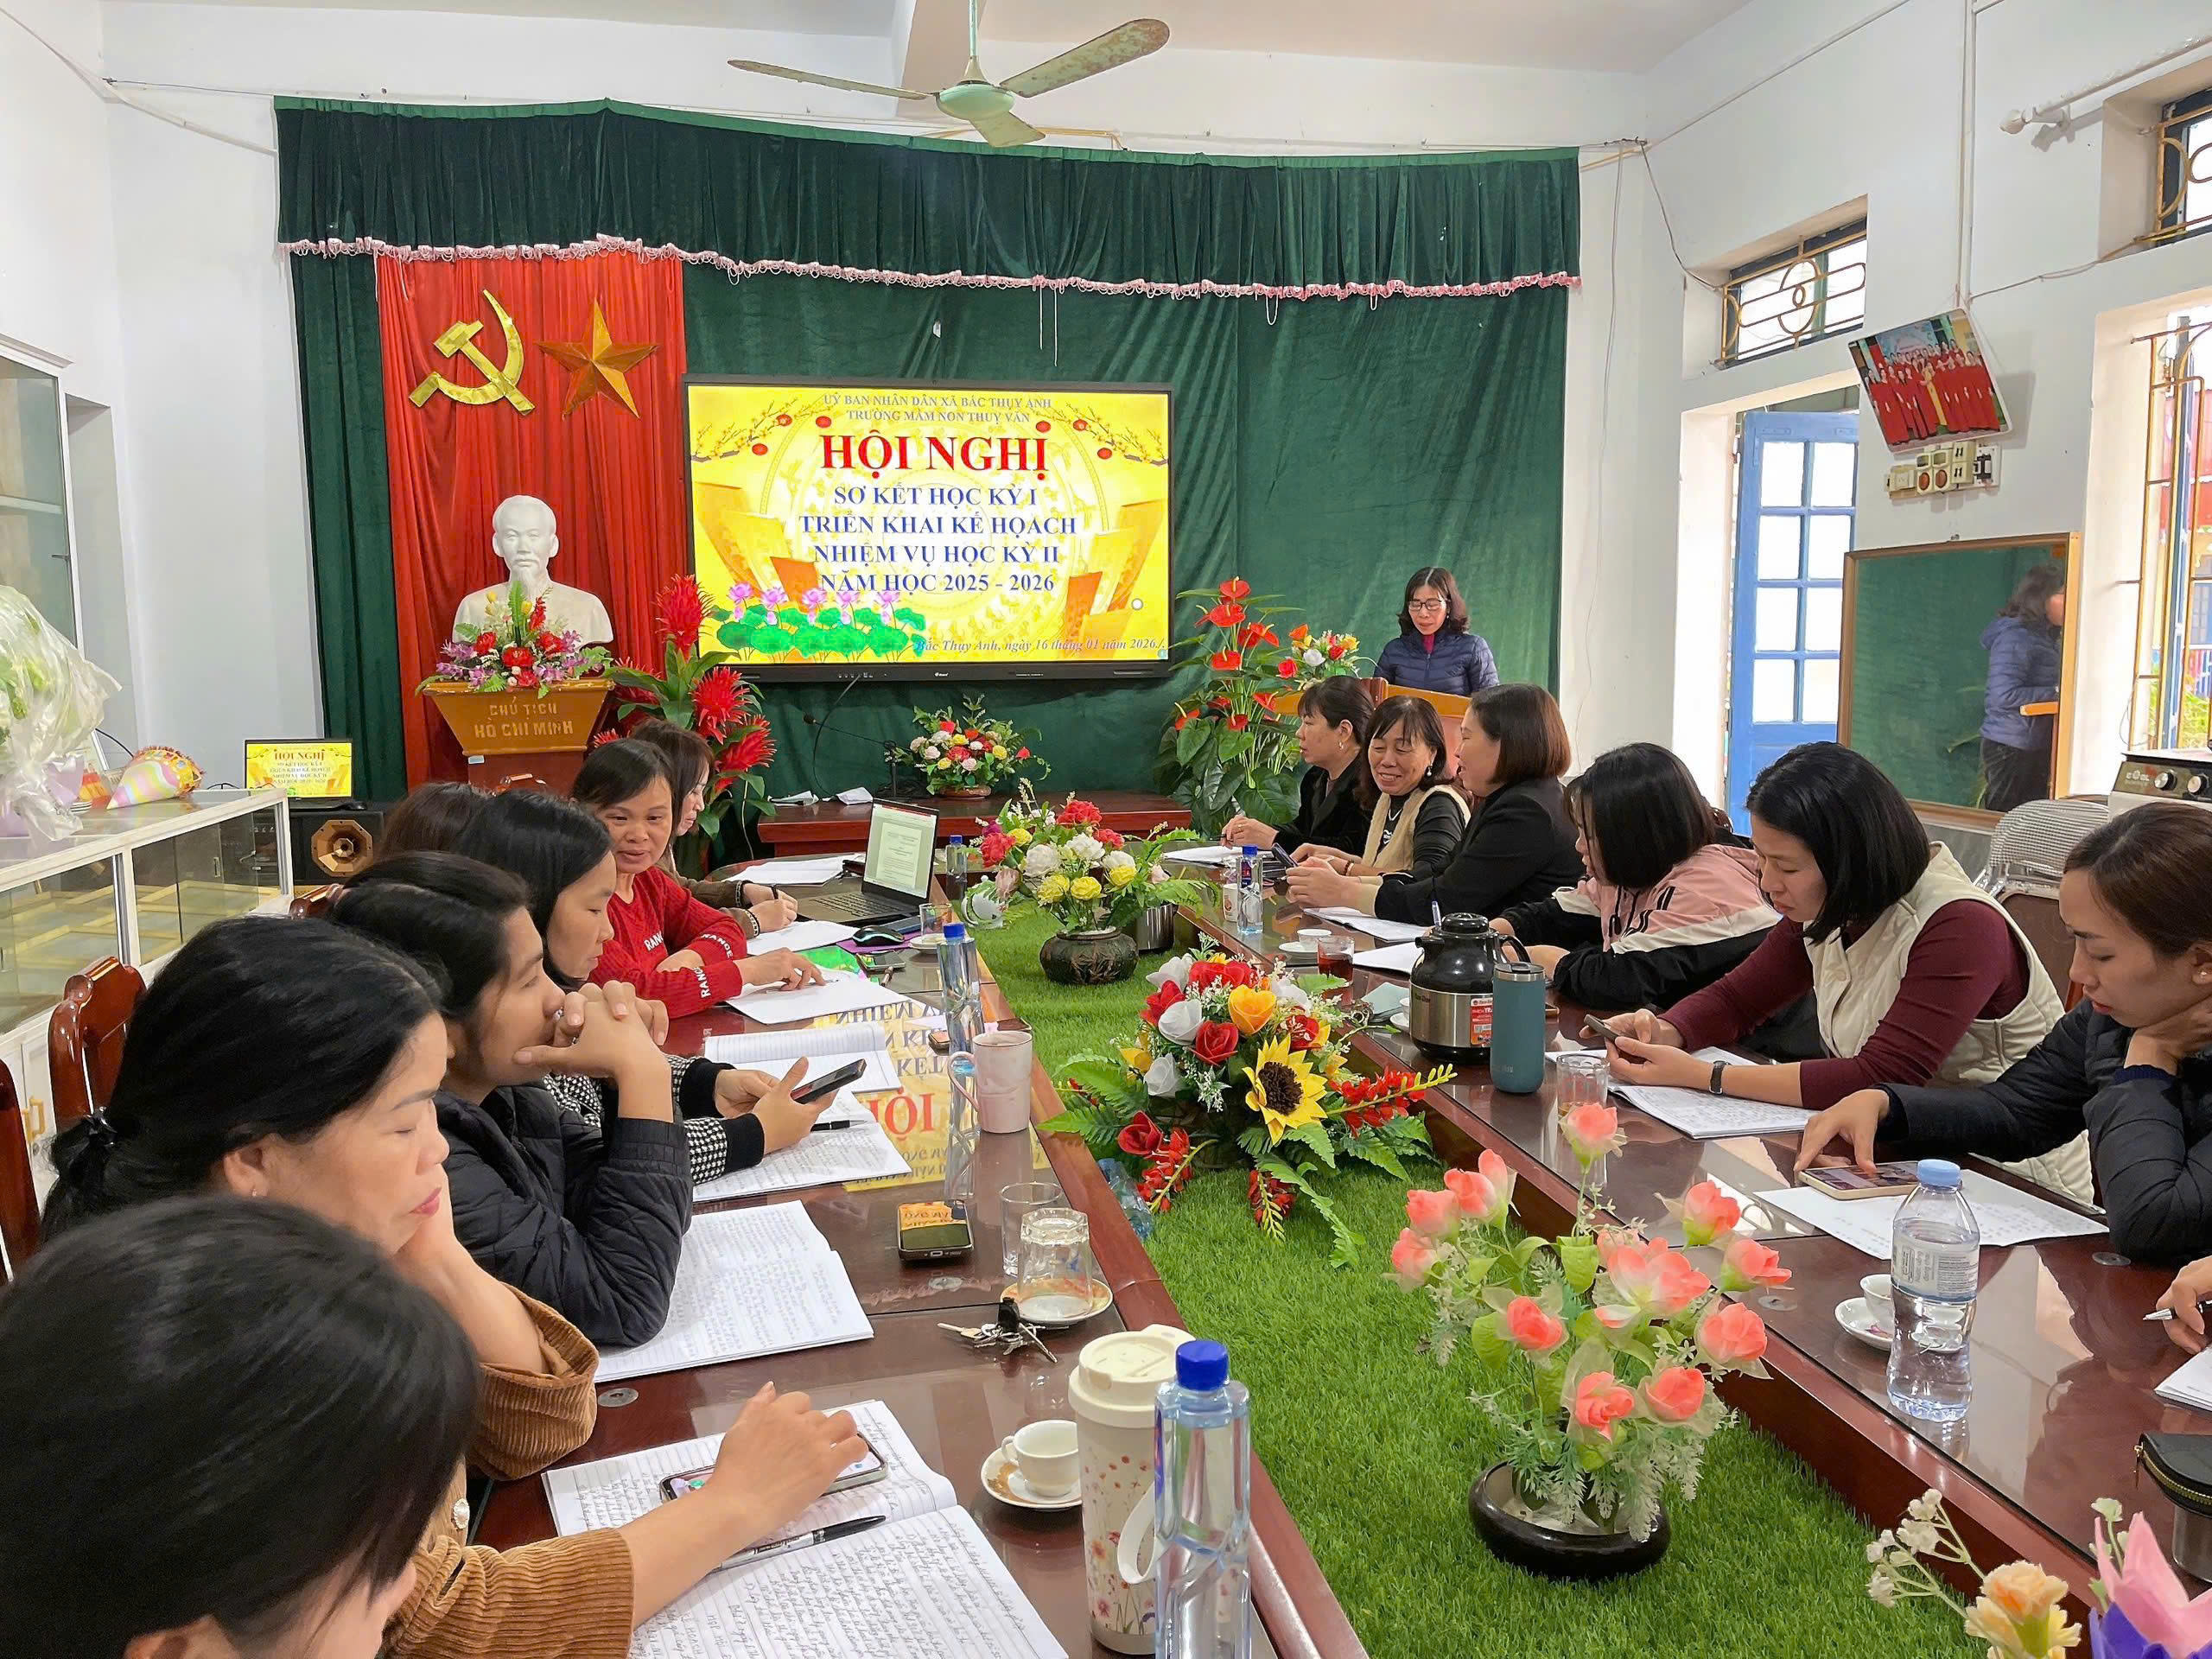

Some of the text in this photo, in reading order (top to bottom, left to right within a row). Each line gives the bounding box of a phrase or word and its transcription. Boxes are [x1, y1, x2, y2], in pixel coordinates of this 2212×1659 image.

[844, 395, 869, 405] BAN
[873, 393, 908, 406] NHÂN
[912, 394, 937, 406] DÂN
[941, 395, 957, 406] XÃ
[1026, 398, 1052, 409] ANH
[847, 408, 900, 421] TRƯỜNG
[904, 407, 934, 421] MẦM
[938, 411, 964, 422] NON
[819, 429, 1049, 481] HỘI NGHỊ
[834, 481, 1038, 510] SƠ KẾT HỌC KỲ I
[798, 511, 874, 534] TRIỂN
[882, 516, 944, 534] KHAI
[952, 510, 984, 534] KẾ
[814, 541, 1060, 568] NHIỆM VỤ HỌC KỲ II
[820, 569, 877, 592] NĂM
[884, 574, 937, 596] HỌC
[944, 574, 990, 592] 2025
[1009, 574, 1055, 592] 2026
[943, 639, 972, 653] Thụy
[974, 639, 1001, 652] Anh,
[1004, 639, 1033, 653] ngày
[1036, 639, 1048, 650] 16
[1051, 639, 1084, 652] tháng
[1086, 639, 1099, 650] 01
[1103, 640, 1127, 650] năm
[474, 717, 497, 738] HỒ
[533, 720, 574, 736] MINH
